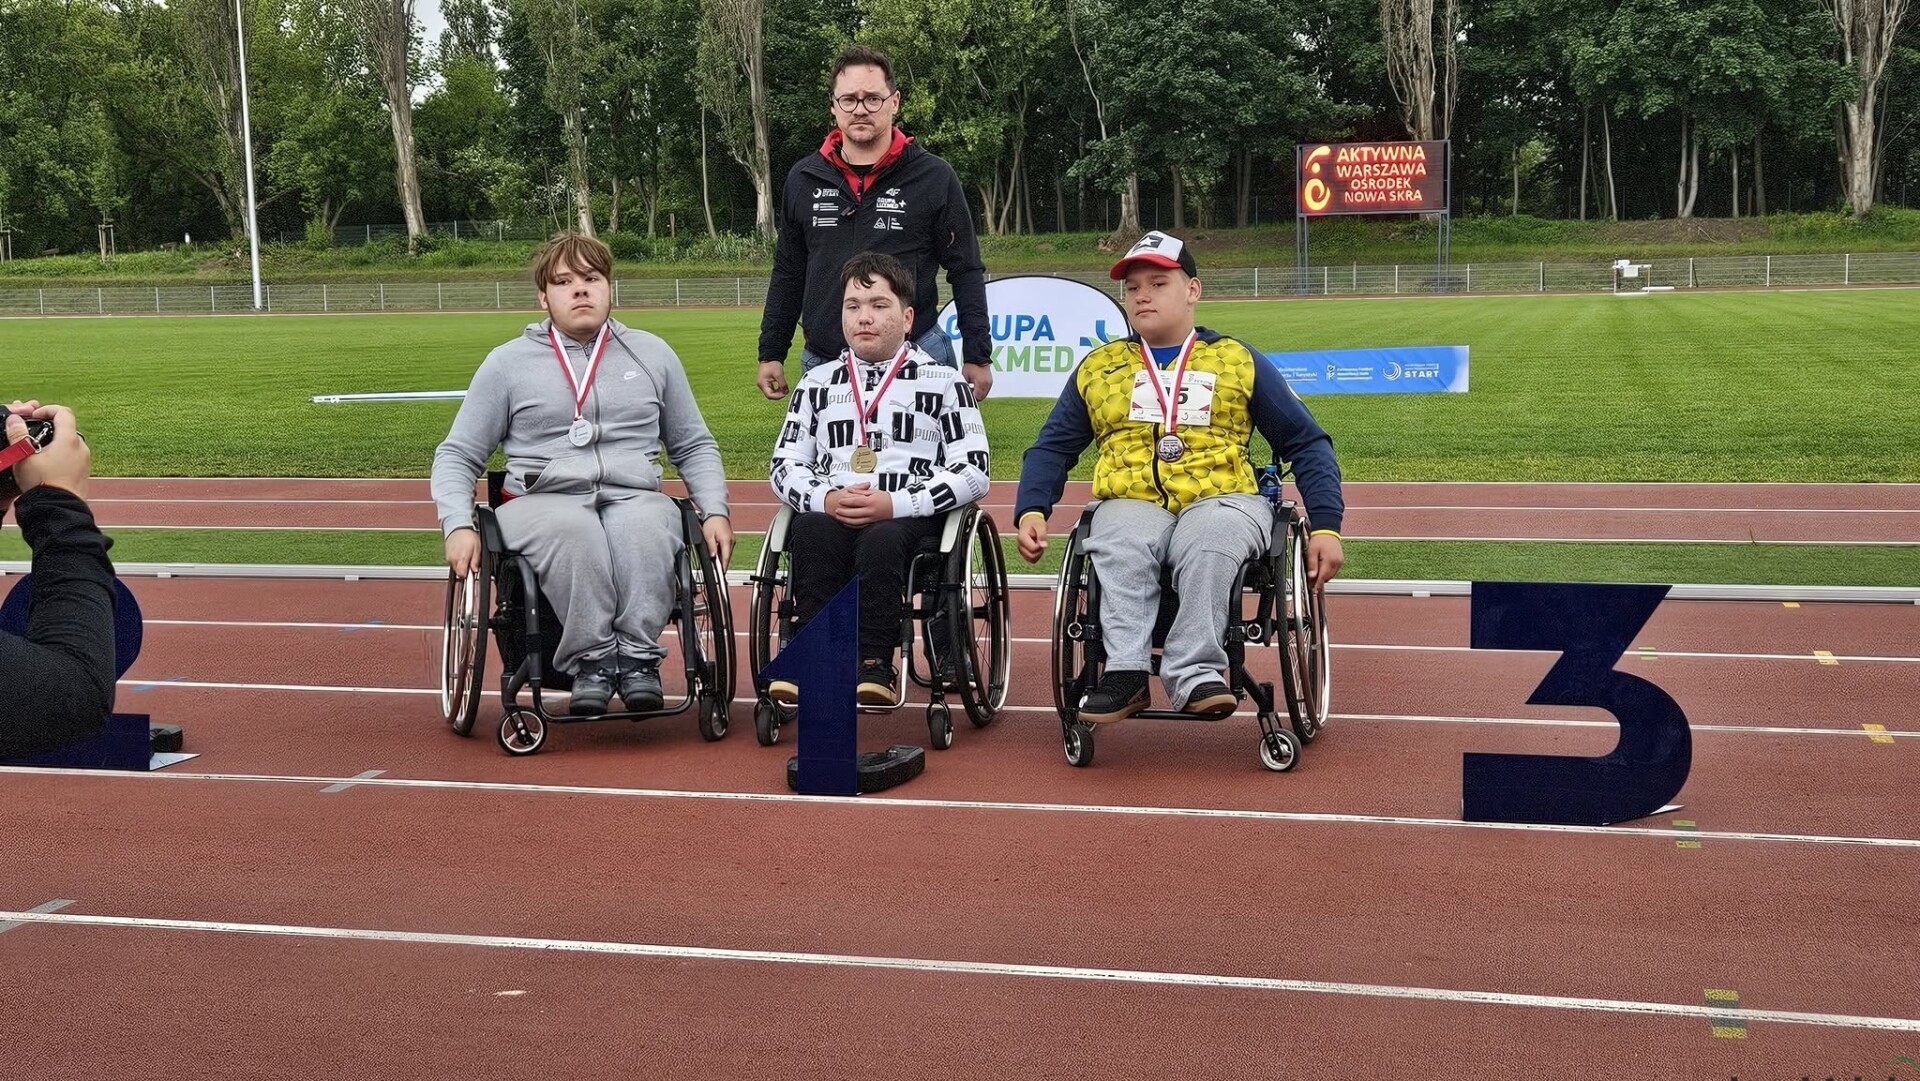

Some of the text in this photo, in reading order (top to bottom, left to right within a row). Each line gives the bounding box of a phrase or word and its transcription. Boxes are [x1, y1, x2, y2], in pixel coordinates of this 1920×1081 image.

[1337, 145, 1425, 162] AKTYWNA
[1336, 162, 1427, 178] WARSZAWA
[1344, 189, 1423, 203] NOWA SKRA
[945, 314, 1055, 341] GUPA
[961, 345, 1074, 373] XMED
[1404, 370, 1440, 378] START
[757, 574, 860, 795] 1
[1462, 581, 1692, 826] 3
